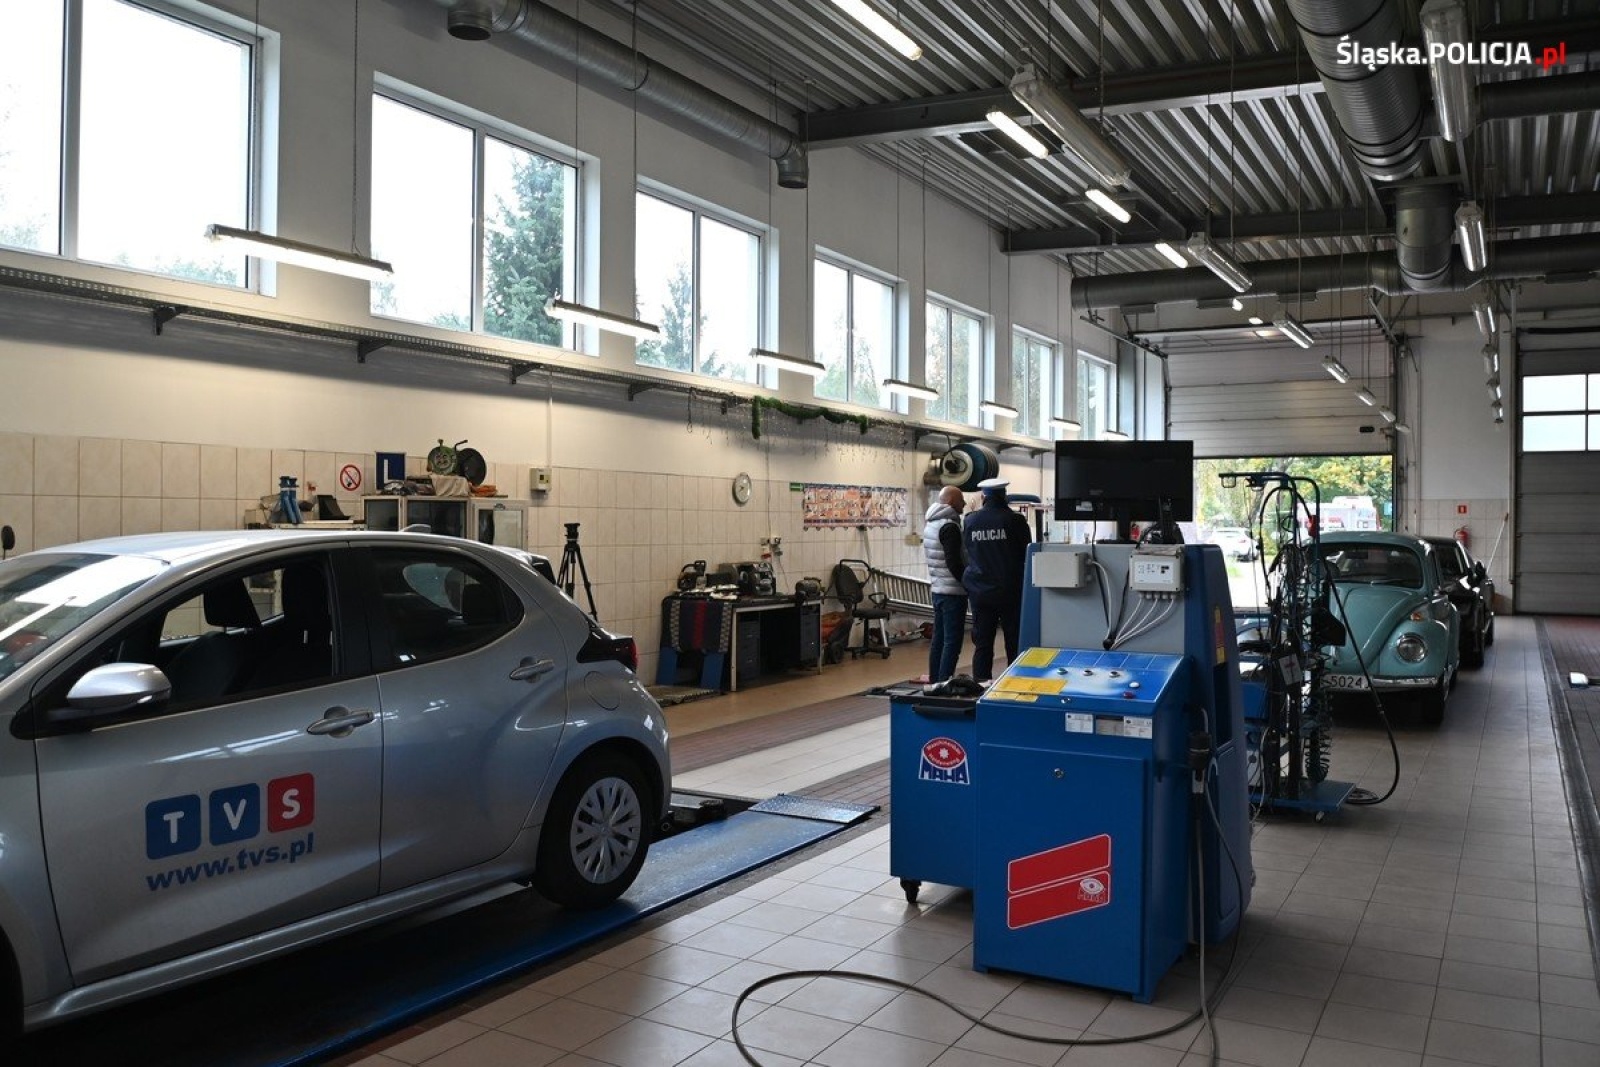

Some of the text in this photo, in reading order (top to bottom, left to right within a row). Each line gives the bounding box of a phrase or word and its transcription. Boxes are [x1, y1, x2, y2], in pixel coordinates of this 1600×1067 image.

[383, 458, 405, 484] L
[971, 528, 1007, 542] POLICJA
[919, 759, 969, 785] MAHA
[163, 788, 301, 844] TVS
[145, 832, 314, 891] www.tvs.pl
